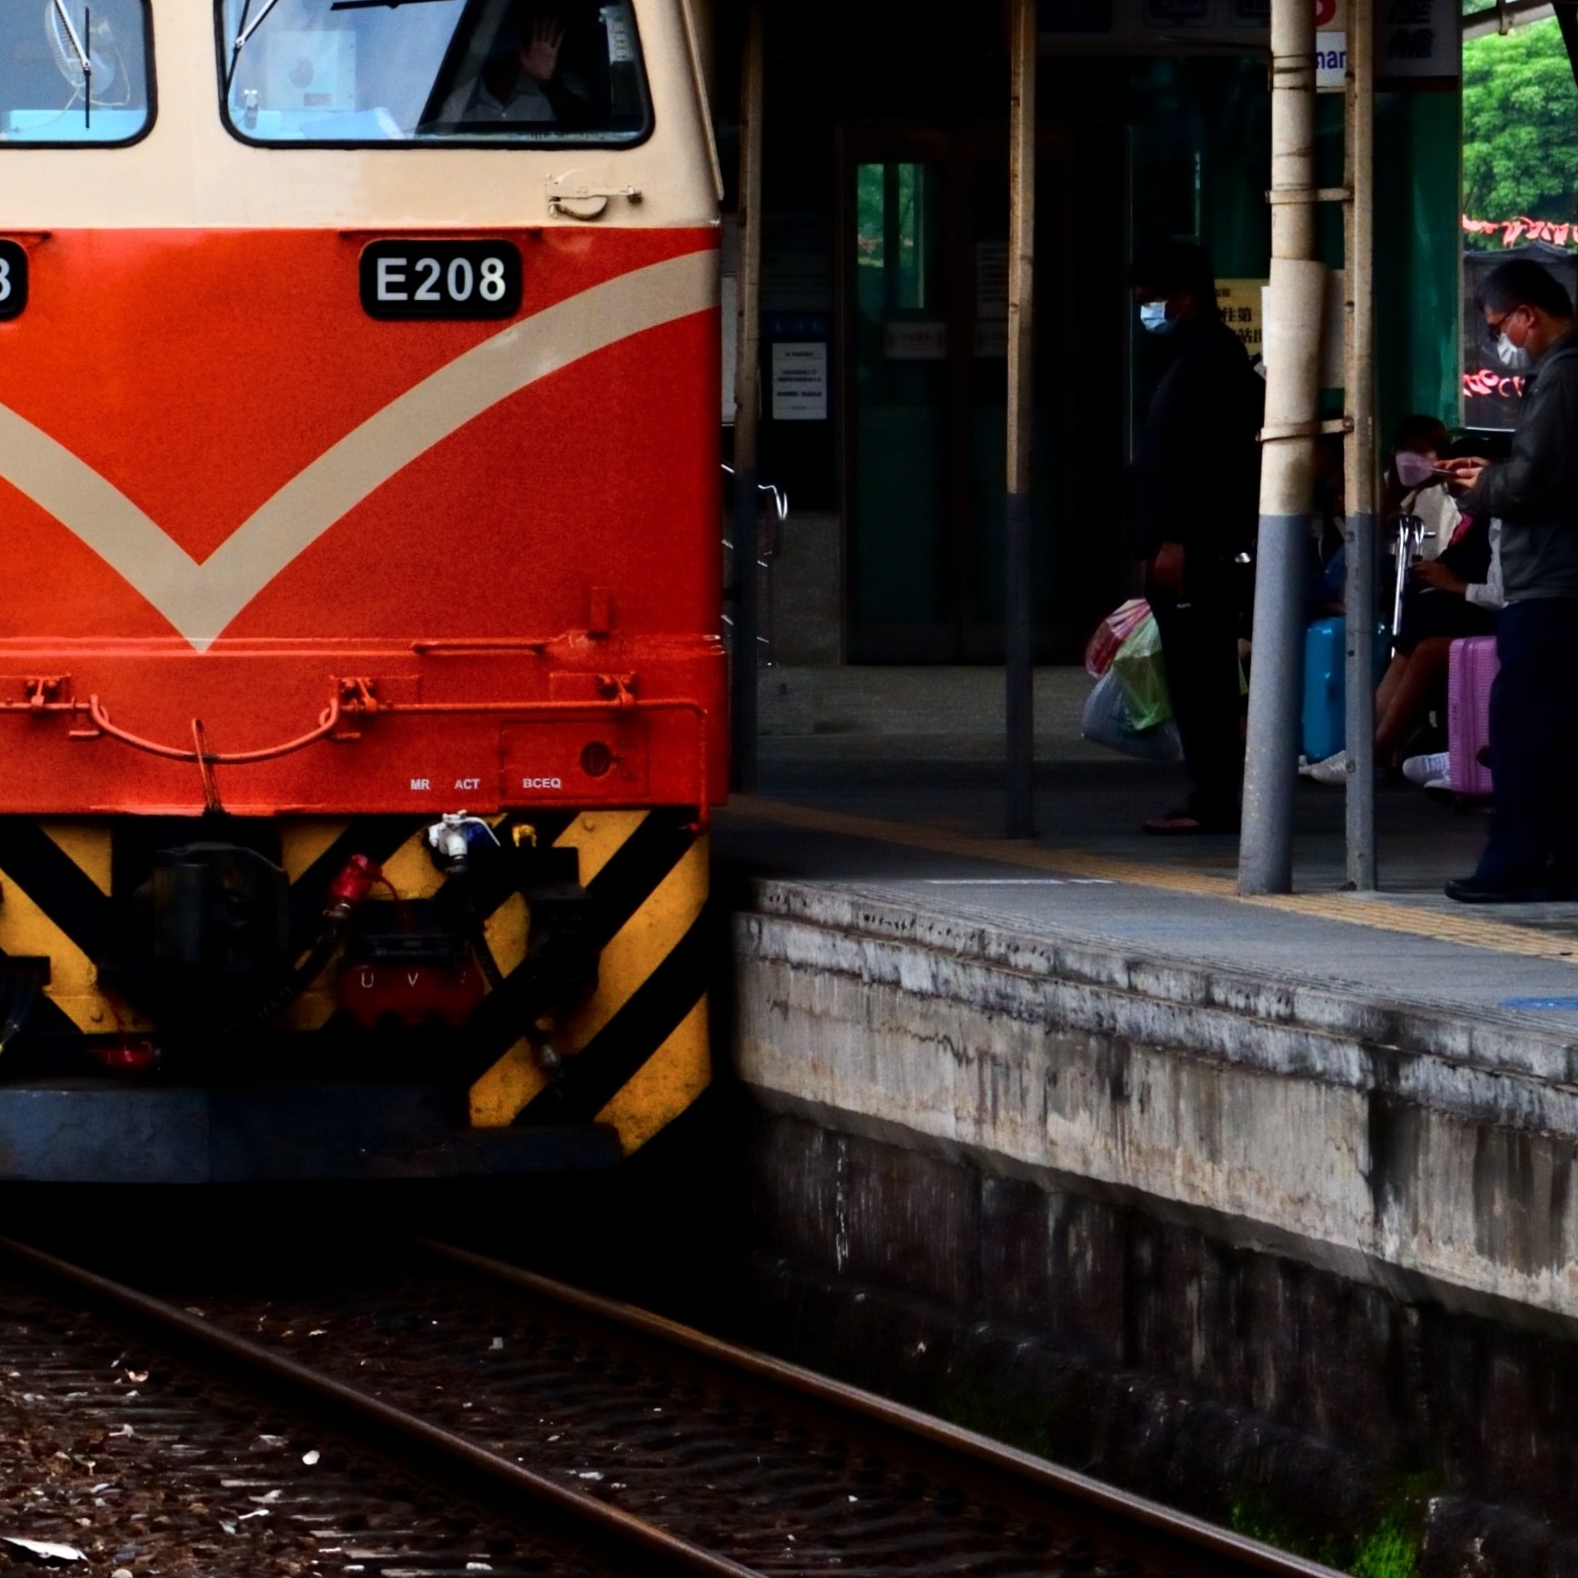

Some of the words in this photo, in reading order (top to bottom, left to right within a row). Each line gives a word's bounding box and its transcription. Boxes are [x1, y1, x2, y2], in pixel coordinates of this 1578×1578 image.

[377, 257, 506, 302] E208
[410, 778, 431, 790] MR
[454, 778, 481, 790] ACT
[523, 777, 562, 789] BCEQ
